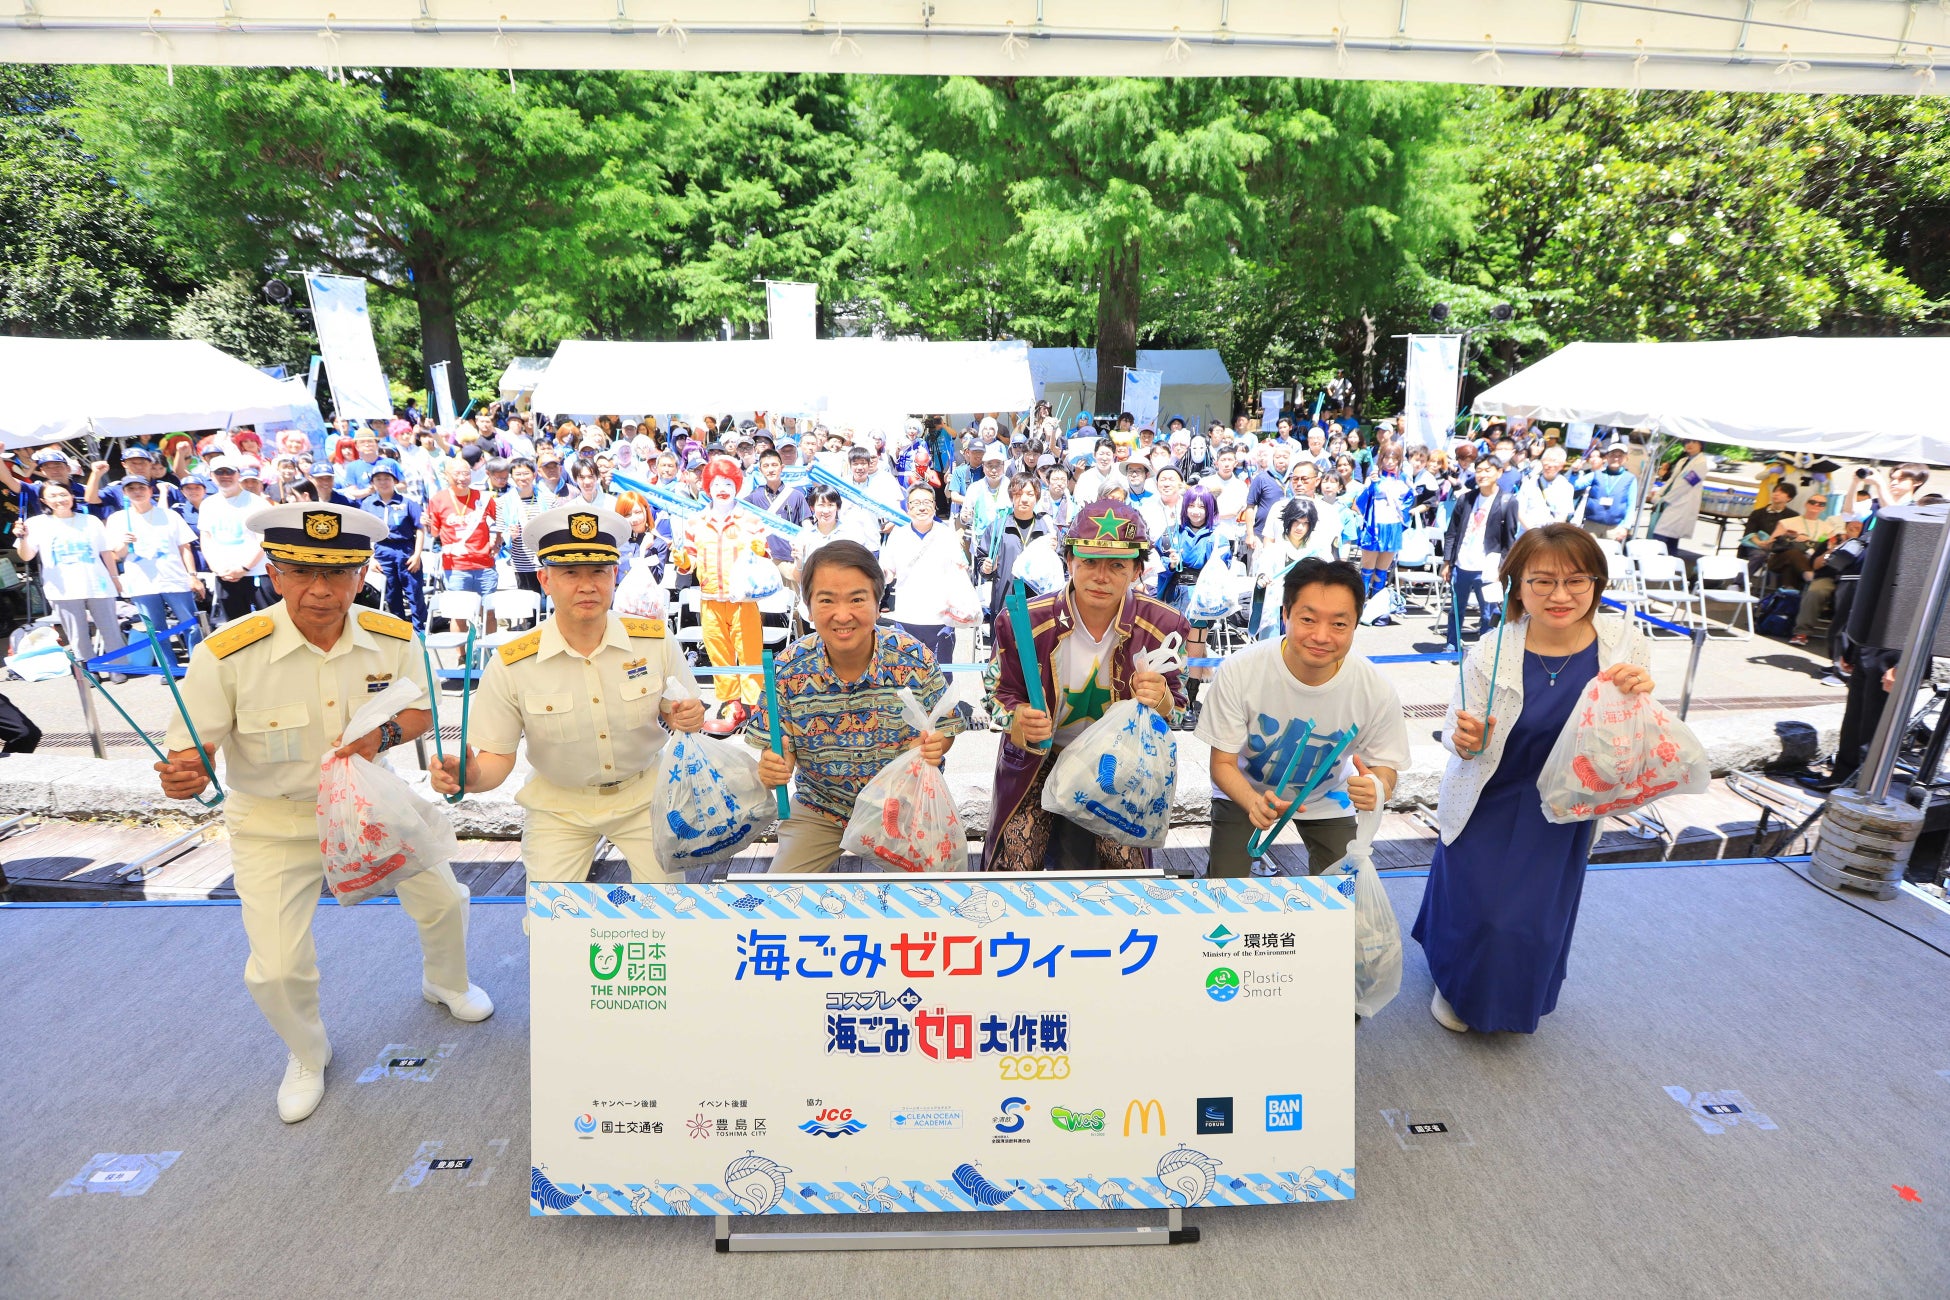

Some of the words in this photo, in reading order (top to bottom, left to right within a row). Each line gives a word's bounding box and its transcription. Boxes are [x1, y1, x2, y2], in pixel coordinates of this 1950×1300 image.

[590, 928, 649, 940] Supported
[652, 929, 666, 940] by
[1244, 932, 1296, 948] 環境省
[627, 942, 666, 960] 日本
[734, 928, 1158, 981] 海ごみゼロウィーク
[627, 963, 666, 981] 財団
[1243, 970, 1294, 983] Plastics
[591, 985, 613, 996] THE
[617, 985, 667, 996] NIPPON
[1243, 984, 1282, 997] Smart
[590, 1000, 667, 1010] FOUNDATION
[1000, 1056, 1071, 1080] 2026
[592, 1099, 657, 1108] キャンペーン後援
[698, 1099, 748, 1108] イベント後援
[806, 1098, 823, 1107] 協力
[1268, 1099, 1299, 1113] BAN
[815, 1108, 853, 1121] JCG
[1268, 1113, 1293, 1127] DAI
[601, 1120, 664, 1134] 国土交通省
